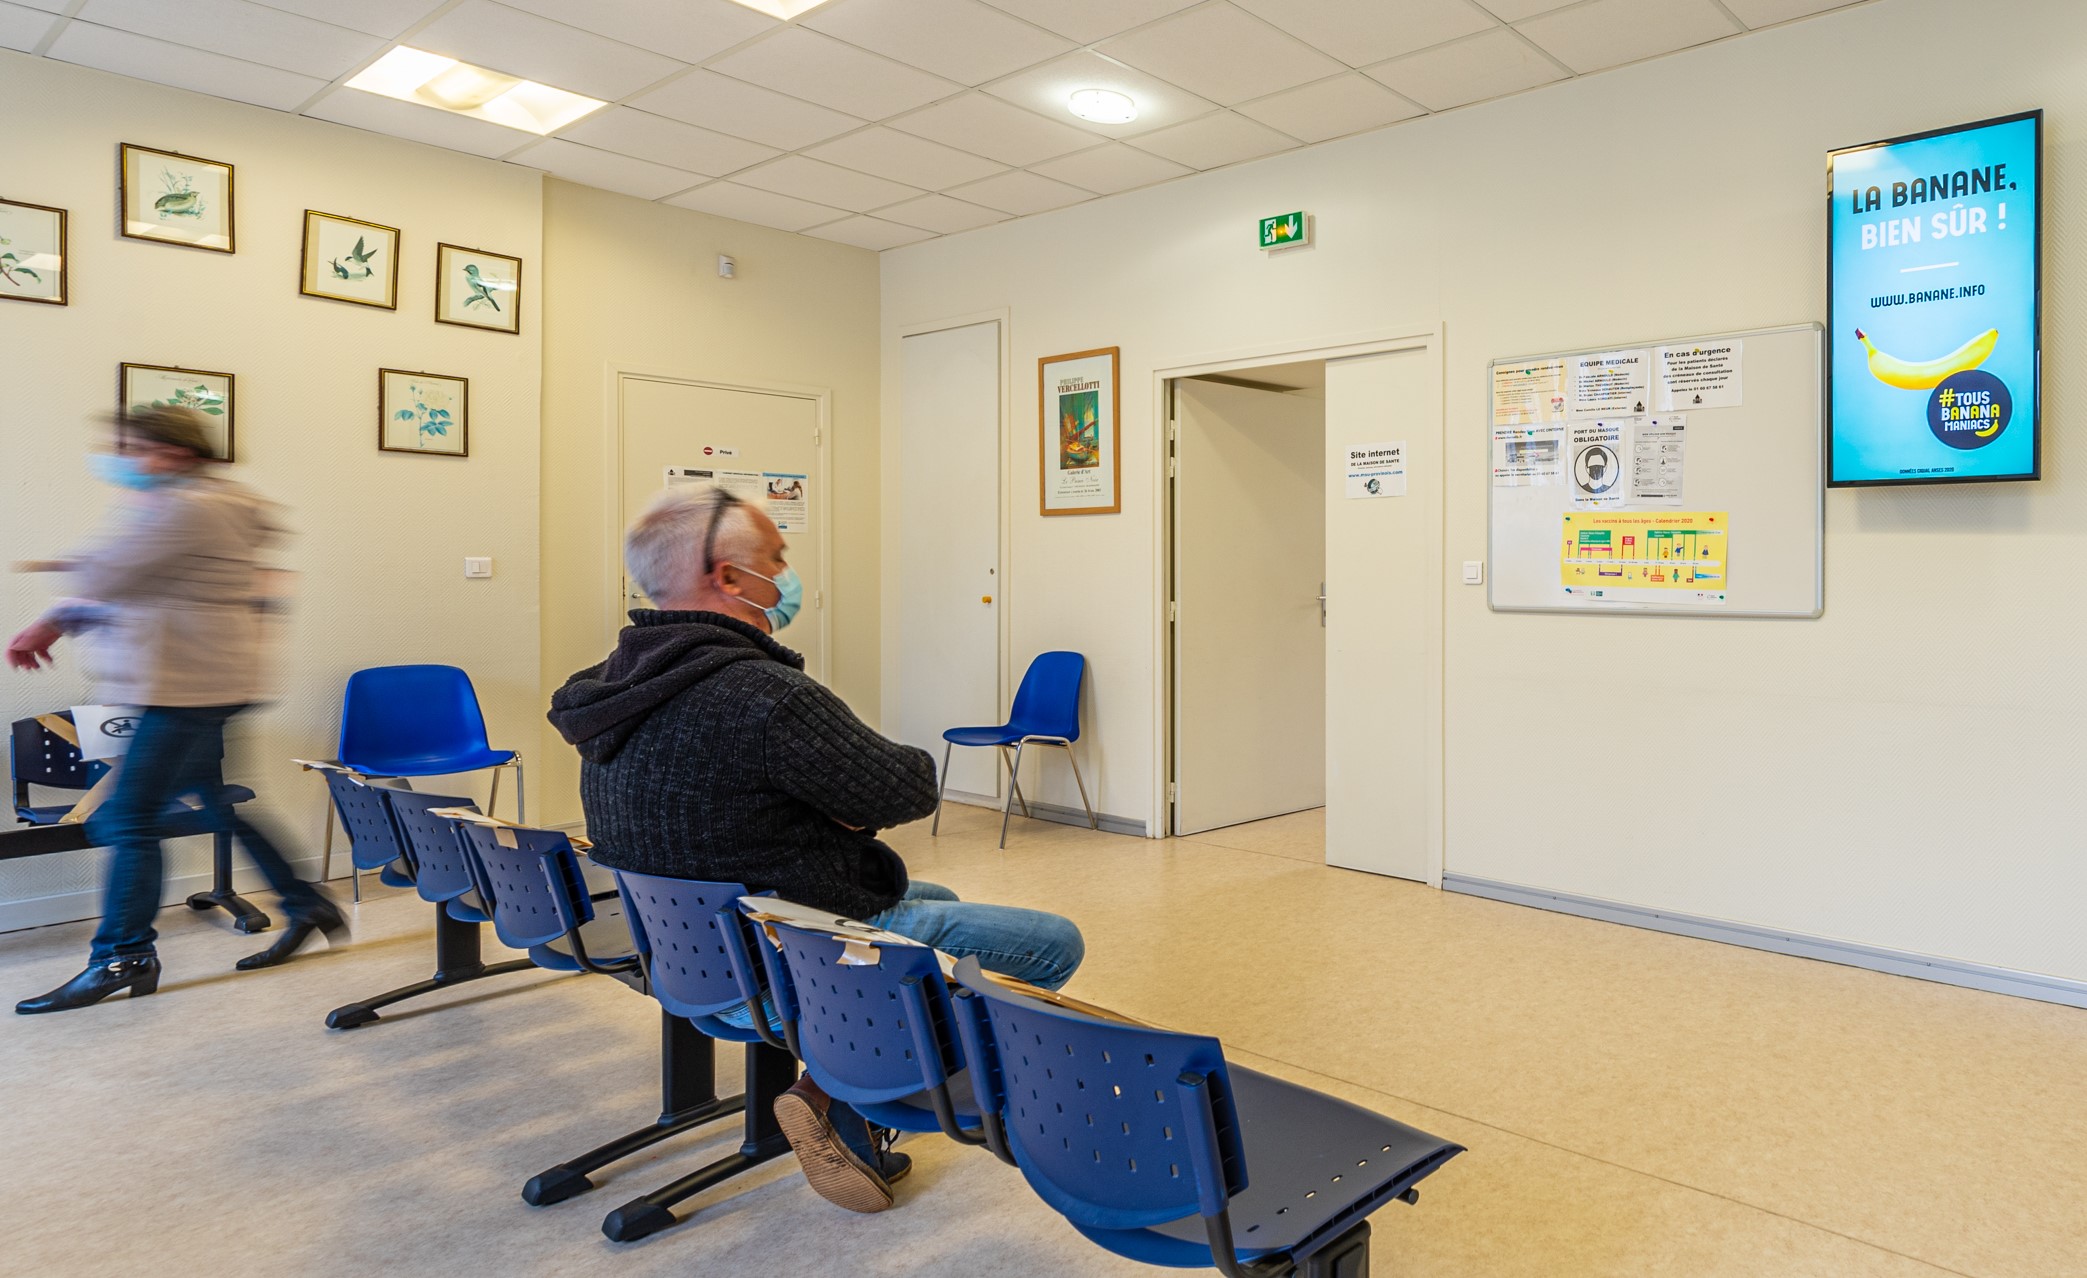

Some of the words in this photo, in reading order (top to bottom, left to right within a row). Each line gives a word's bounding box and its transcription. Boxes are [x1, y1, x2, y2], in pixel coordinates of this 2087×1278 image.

[1853, 185, 1881, 214] LA
[1892, 163, 2017, 208] BANANE,
[1861, 216, 1921, 250] BIEN
[1931, 203, 1987, 240] SÛR
[1998, 202, 2006, 230] !
[1870, 284, 1985, 308] WWW.BANANE.INFO
[1058, 381, 1099, 393] VERCELLOTTI
[1939, 388, 1990, 407] #TOUS
[1941, 404, 2000, 421] BANANA
[1944, 419, 1990, 432] MANIACS
[1368, 448, 1399, 457] internet
